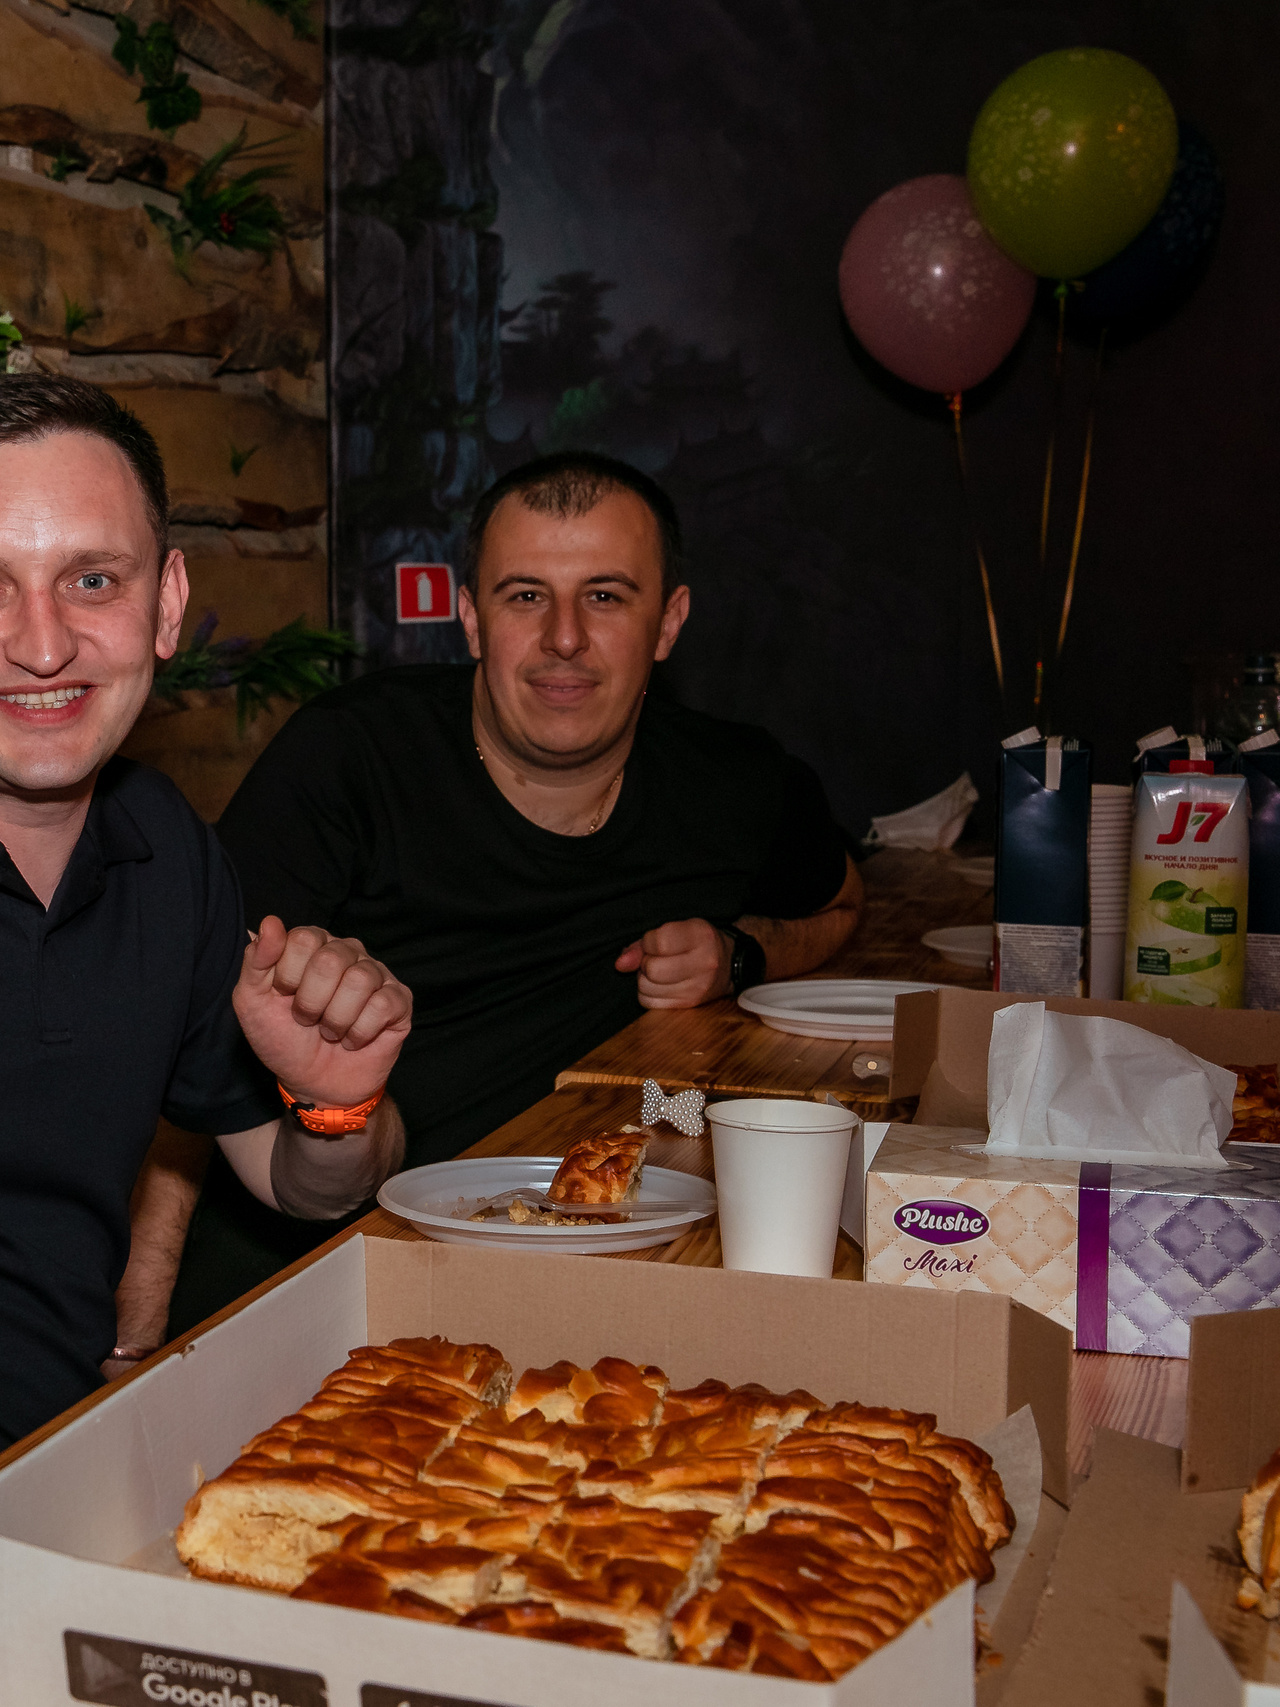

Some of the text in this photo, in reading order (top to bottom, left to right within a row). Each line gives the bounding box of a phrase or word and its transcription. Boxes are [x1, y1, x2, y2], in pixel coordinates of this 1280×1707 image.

[1156, 801, 1231, 845] J7
[1144, 853, 1178, 862] ВКУСНОЕ
[1188, 855, 1239, 864] ПОЗИТИВНОЕ
[1164, 862, 1198, 870] НАЧАЛО
[901, 1207, 984, 1233] Plushe
[903, 1249, 978, 1278] Maxi
[139, 1652, 238, 1686] ДОСТУПНО
[141, 1672, 249, 1707] Google
